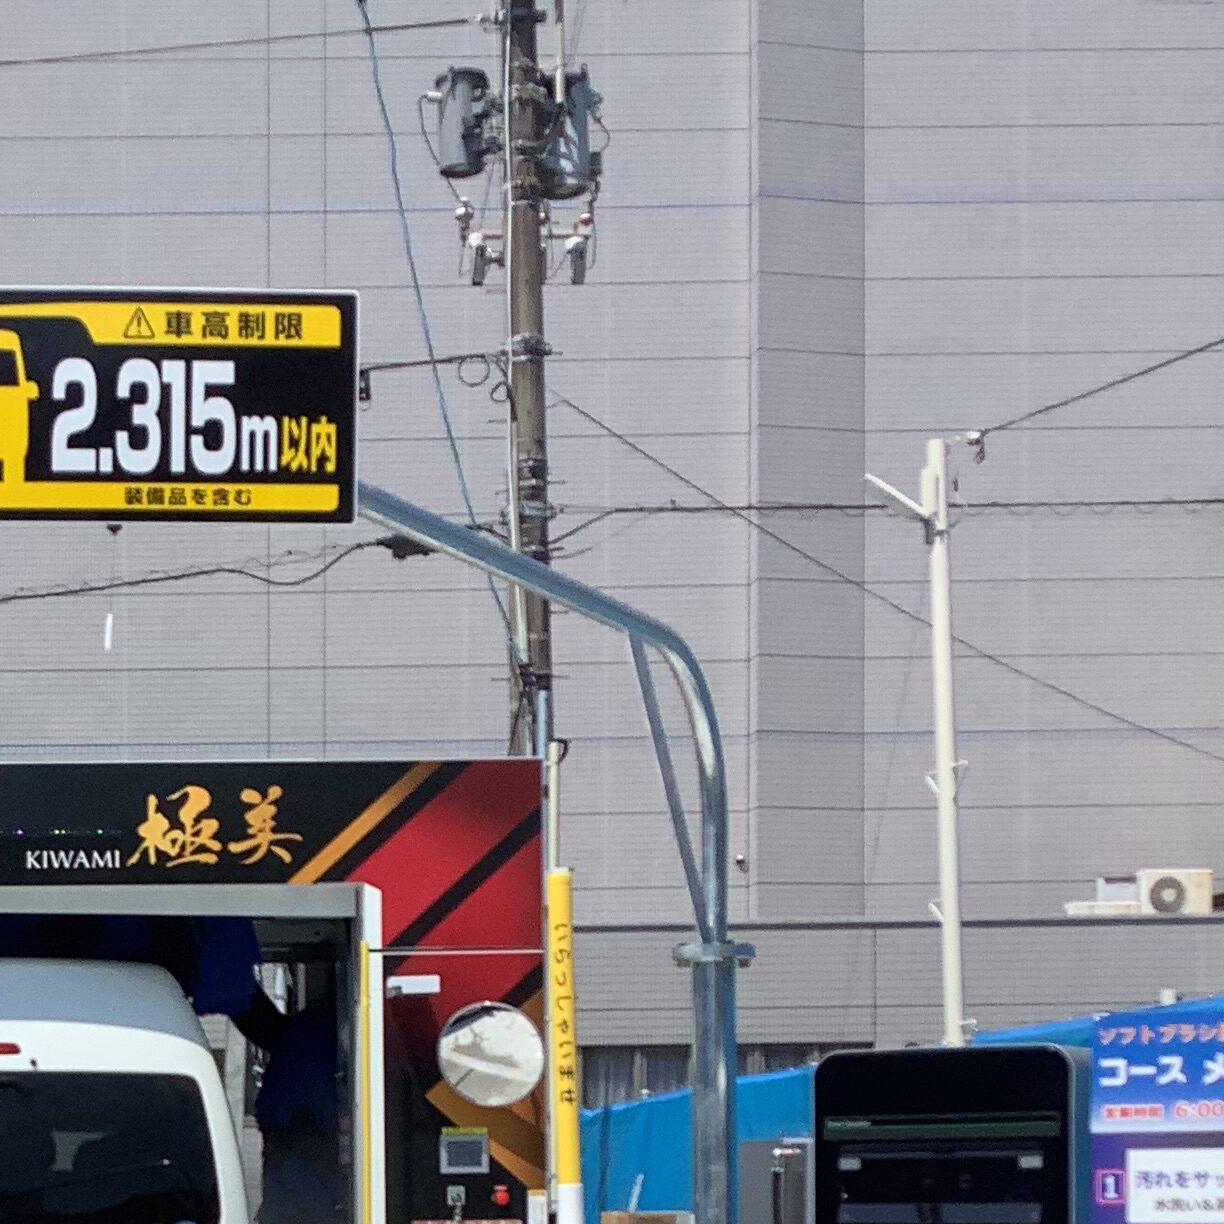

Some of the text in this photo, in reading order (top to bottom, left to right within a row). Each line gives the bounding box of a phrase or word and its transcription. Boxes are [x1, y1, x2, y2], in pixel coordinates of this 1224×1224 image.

[164, 311, 303, 340] 車高制限
[125, 488, 252, 506] 装備品を含む
[126, 784, 303, 867] 極美
[26, 849, 120, 869] KIWAMI
[553, 924, 576, 1104] いらっしゃいませ
[1099, 1024, 1224, 1044] ソフトブラシ
[1099, 1055, 1187, 1087] コース
[1103, 1174, 1119, 1199] 1
